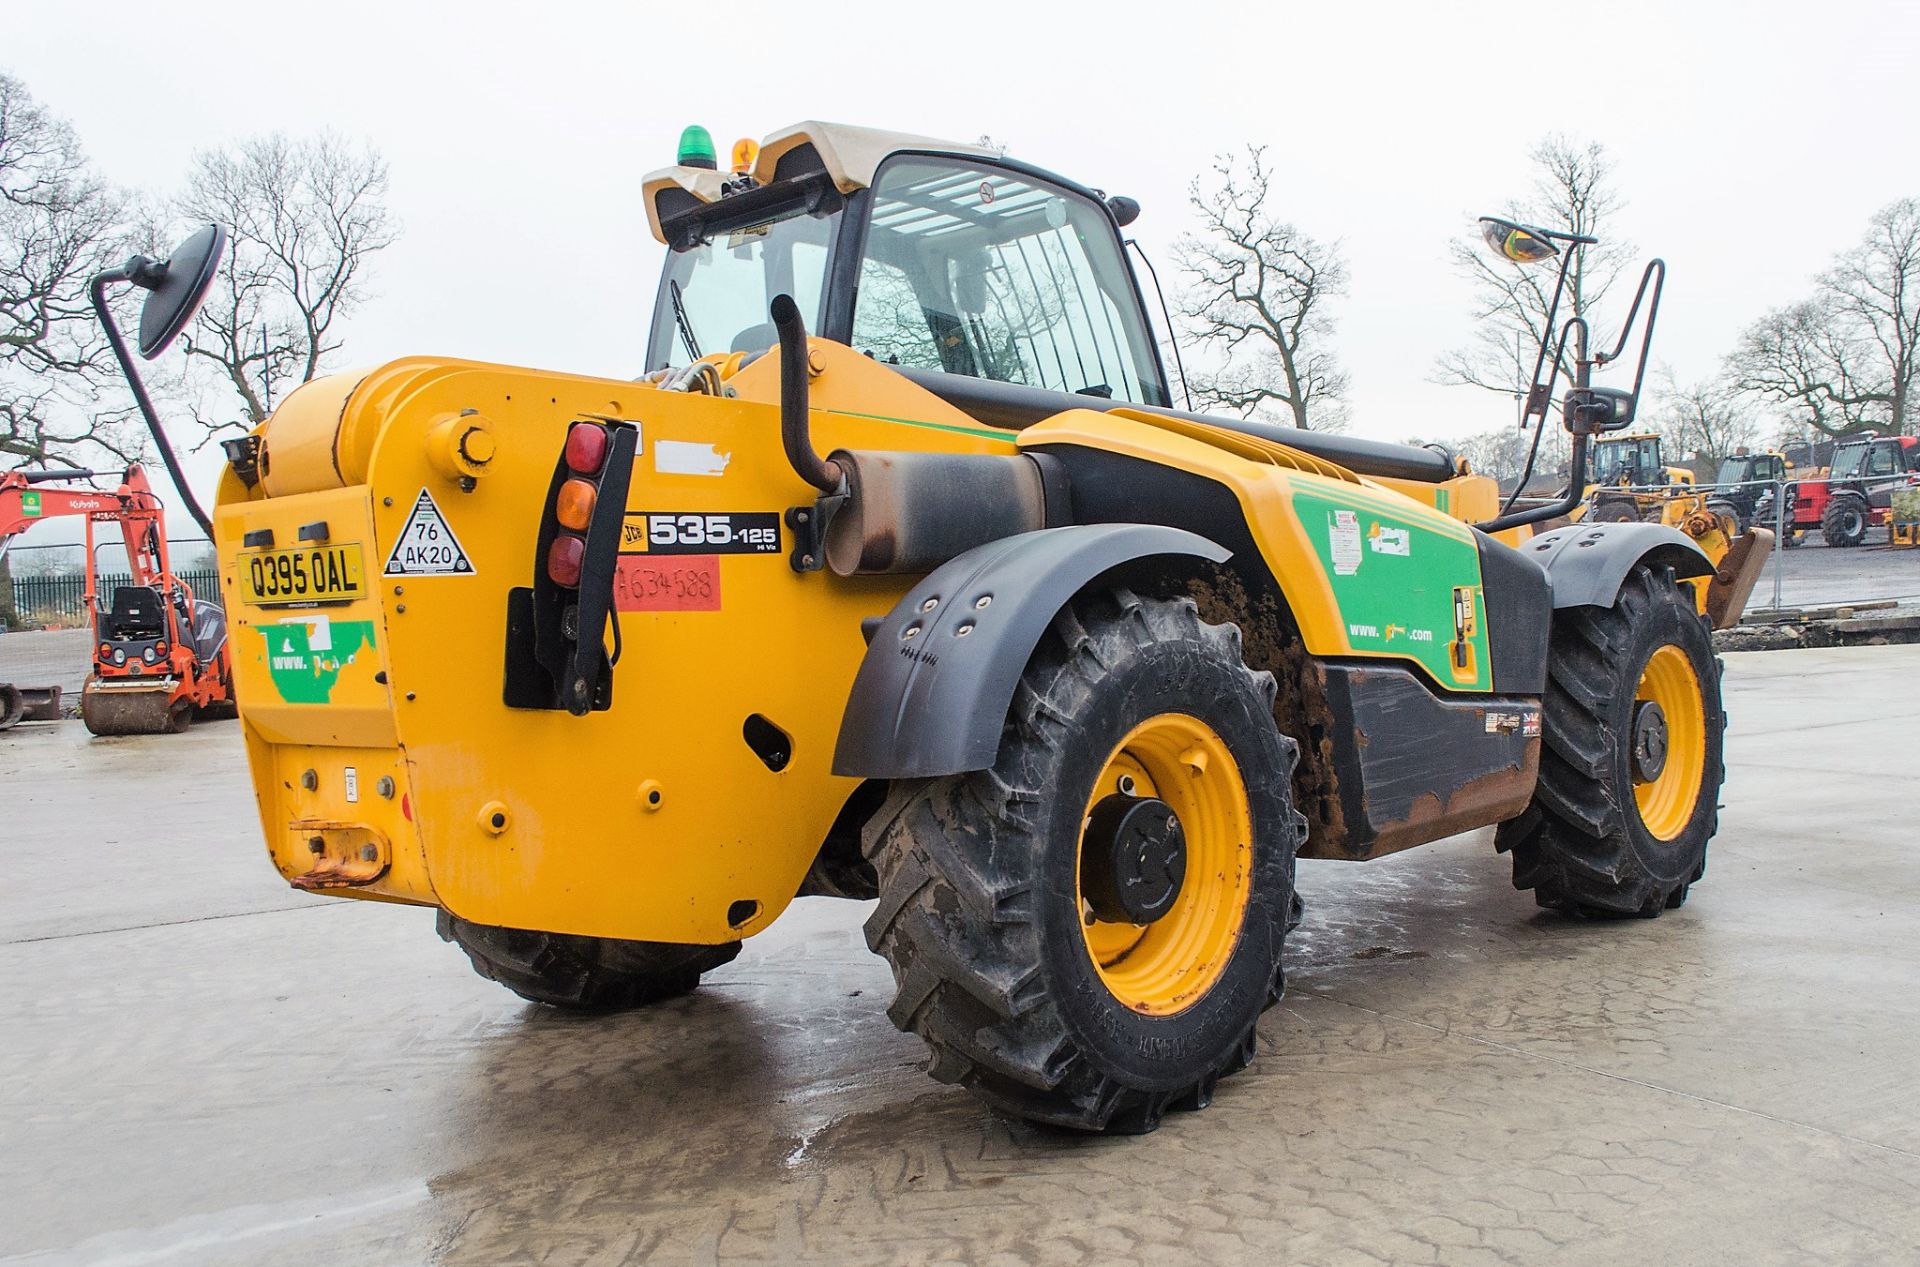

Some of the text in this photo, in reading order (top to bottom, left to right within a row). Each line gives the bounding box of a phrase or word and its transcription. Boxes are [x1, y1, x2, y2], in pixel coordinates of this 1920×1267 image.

[69, 499, 100, 509] Kubota
[416, 523, 438, 541] 76
[624, 524, 643, 543] JCB
[405, 546, 452, 565] AK20
[251, 550, 357, 597] Q395 OAL
[272, 655, 308, 670] www.
